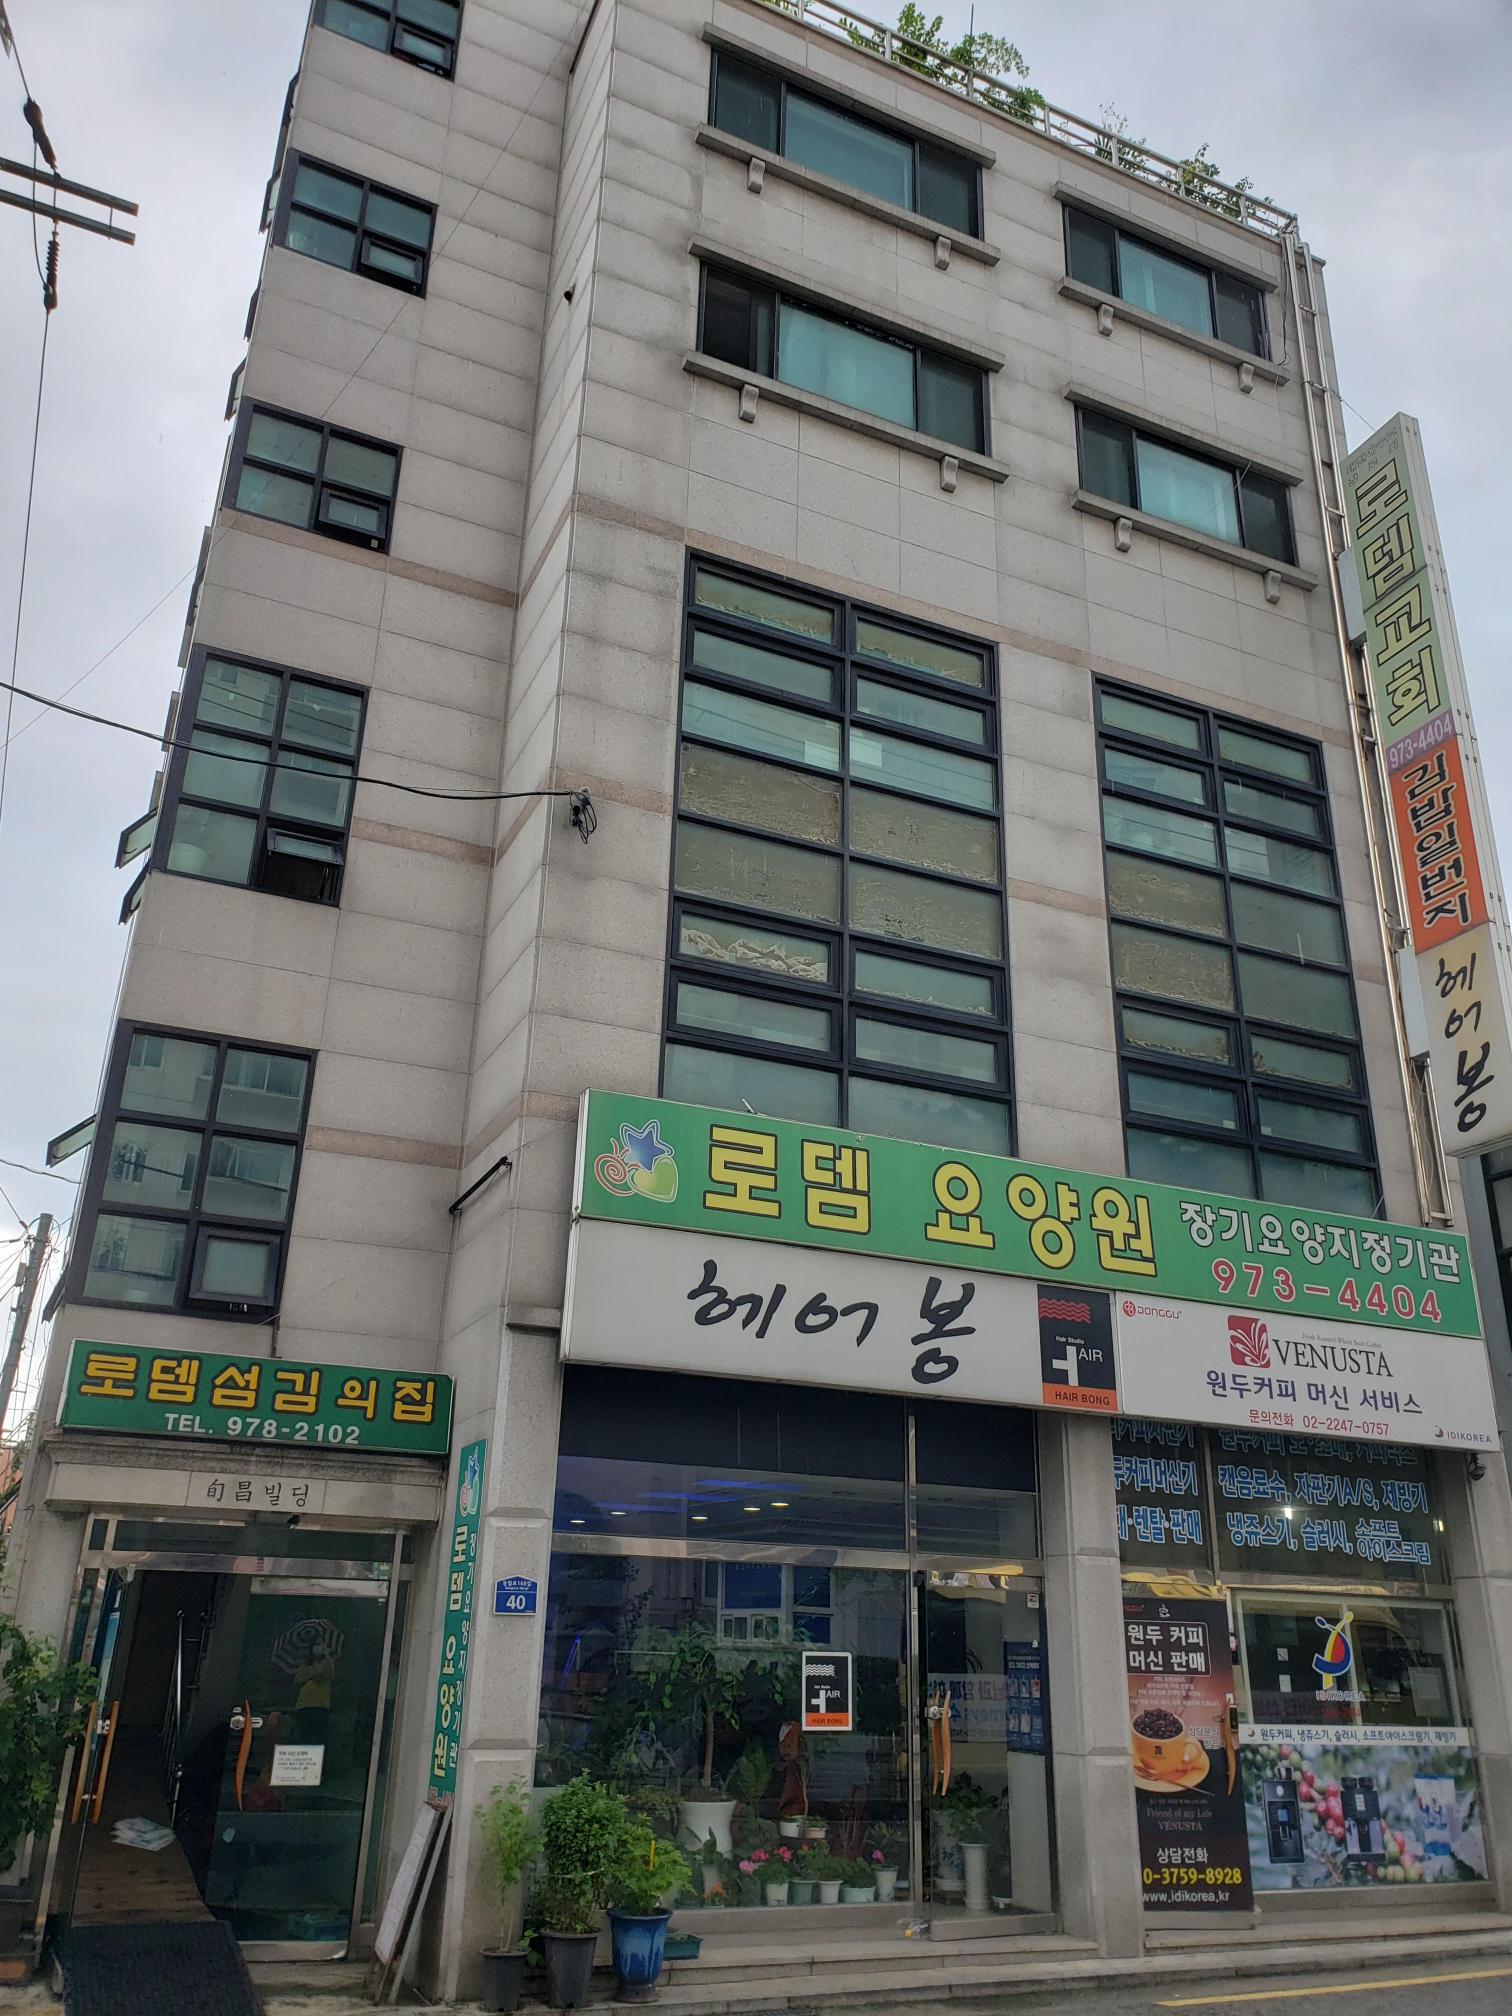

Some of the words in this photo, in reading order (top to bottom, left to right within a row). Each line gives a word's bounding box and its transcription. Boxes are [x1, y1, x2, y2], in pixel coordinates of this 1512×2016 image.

[1354, 458, 1441, 727] 로뎀교회
[1389, 713, 1453, 769] 973-4404
[1402, 752, 1470, 928] 김밥일번지
[703, 1123, 871, 1235] 로뎀
[924, 1160, 1157, 1277] 요양원
[1180, 1202, 1460, 1284] 장기요양지정기관
[1212, 1258, 1442, 1323] 973-4404
[1272, 1339, 1394, 1378] VENUSTA
[1055, 1391, 1078, 1403] HAIR
[1081, 1393, 1110, 1406] BONG
[1206, 1370, 1297, 1402] 원두커피
[1306, 1382, 1349, 1411] 머신
[1360, 1389, 1423, 1416] 서비스
[165, 1413, 213, 1433] TEL.
[227, 1416, 360, 1445] 978-2102
[1249, 1409, 1294, 1427] 문의전화
[1302, 1415, 1389, 1436] 02-2247-0757
[1447, 1431, 1492, 1445] IDIKOREA
[1217, 1465, 1291, 1504] 캔음료수,
[1294, 1472, 1380, 1511] 자판기A/S,
[1380, 1479, 1429, 1513] 제빙기
[1227, 1512, 1297, 1551] 냉쥬스기,
[1300, 1518, 1353, 1555] 슬러시,
[1355, 1518, 1401, 1541] 소프트
[1357, 1539, 1431, 1565] 아이스크림
[506, 1595, 526, 1609] 40
[1127, 1624, 1163, 1645] 원두
[1169, 1626, 1204, 1647] 커피
[1129, 1650, 1164, 1671] 머신
[1170, 1651, 1206, 1672] 판매
[434, 1634, 456, 1777] 요양원
[1260, 1729, 1295, 1741] 원두커피,
[1297, 1730, 1332, 1742] 냉쥬스기,
[1334, 1730, 1360, 1742] 슬러시,
[1158, 1822, 1203, 1831] VENUSTA
[1156, 1847, 1208, 1864] 상담전화
[1142, 1890, 1230, 1903] www.idikorea.kr
